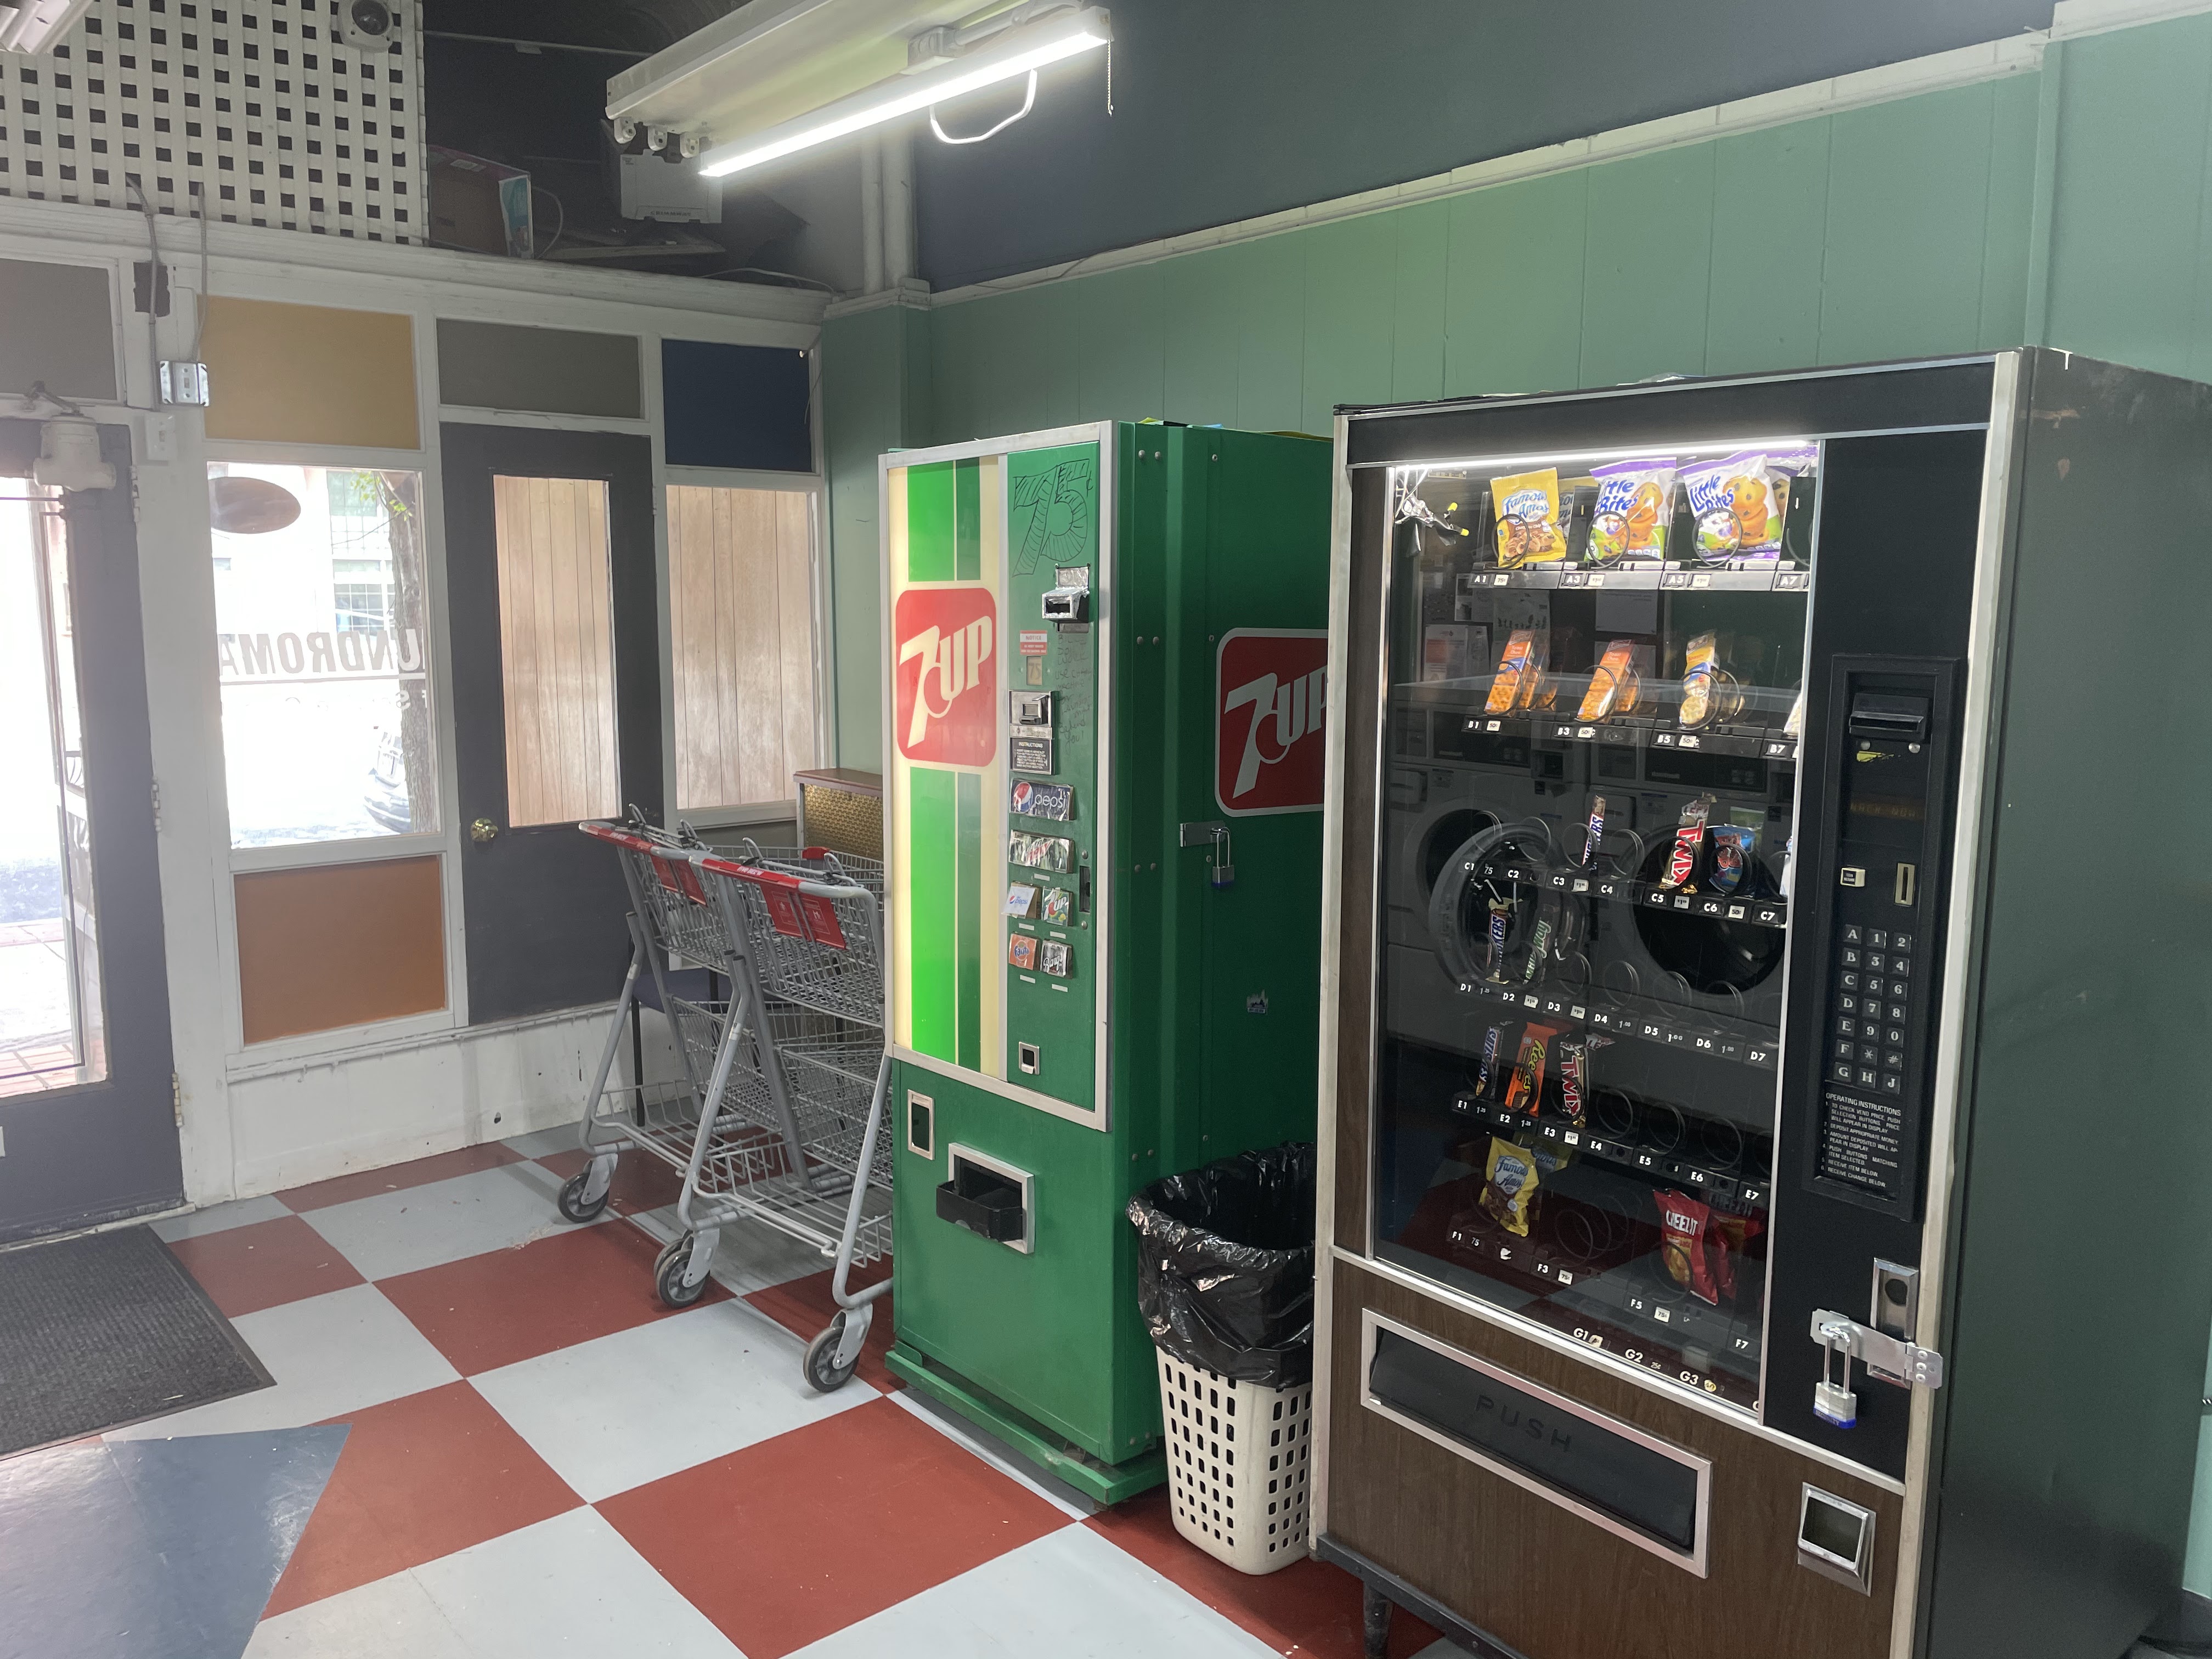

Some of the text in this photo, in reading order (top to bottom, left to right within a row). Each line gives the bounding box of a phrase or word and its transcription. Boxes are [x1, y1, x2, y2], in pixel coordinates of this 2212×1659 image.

[1690, 475, 1721, 512] Little
[1503, 492, 1547, 515] Famous
[1600, 495, 1639, 512] Bites
[1515, 503, 1549, 523] Amos
[1566, 575, 1581, 584] A3
[1669, 575, 1684, 584] A5
[1780, 576, 1798, 585] A7
[1468, 720, 1479, 729] B1
[1557, 727, 1570, 736] B3
[1657, 733, 1671, 744] B5
[1769, 744, 1785, 754] B7
[1034, 794, 1066, 810] pepsi
[1464, 862, 1475, 871] C1
[1484, 866, 1493, 874] 75
[1508, 870, 1519, 878] C2
[1553, 877, 1565, 886] C3
[1601, 884, 1613, 894] C4
[1651, 893, 1664, 903] C5
[1703, 903, 1718, 912] C6
[1760, 911, 1775, 921] C7
[1848, 929, 1905, 947] A 1 2
[1014, 945, 1030, 957] Fanta
[1847, 952, 1904, 971] B 3 4
[1460, 983, 1471, 992] D1
[1844, 975, 1902, 994] C 5 6
[1503, 992, 1515, 1001] D2
[1548, 1002, 1560, 1012] D3
[1843, 998, 1900, 1018] D 7 8
[1594, 1014, 1607, 1024] D4
[1645, 1025, 1658, 1036] D5
[1842, 1021, 1899, 1041] E 9 0
[1696, 1038, 1712, 1048] D6
[1840, 1044, 1849, 1053] F
[1750, 1051, 1766, 1062] D7
[1838, 1067, 1895, 1088] G H J
[1458, 1100, 1468, 1110] E1
[1826, 1092, 1901, 1116] OPERATING INSTRUCTIONS
[1499, 1114, 1511, 1124] E2
[1831, 1109, 1857, 1119] SELECTION
[1886, 1122, 1900, 1131] PRICE
[1839, 1104, 1855, 1113] CHECK
[1887, 1116, 1900, 1125] PUSH
[1843, 1118, 1861, 1127] APPEAR
[1544, 1127, 1556, 1137] E3
[1830, 1123, 1849, 1132] DEPOSIT
[1849, 1128, 1881, 1141] APPROPRIATE
[1590, 1141, 1602, 1151] E4
[1830, 1131, 1849, 1141] AMOUNT
[1850, 1136, 1876, 1148] DEPOSITED
[1877, 1143, 1889, 1152] WILL
[1639, 1155, 1651, 1166] E5
[1828, 1159, 1847, 1169] RECEIVE
[1846, 1149, 1867, 1160] BUTTONS
[1872, 1156, 1898, 1168] MATCHING
[1494, 1156, 1528, 1177] Famous
[1690, 1171, 1703, 1182] E6
[1827, 1167, 1847, 1177] RECEIVE
[1848, 1172, 1867, 1182] CHANGE
[1497, 1174, 1523, 1188] Amos
[1745, 1189, 1759, 1200] E7
[1452, 1231, 1462, 1241] F1
[1471, 1237, 1480, 1246] 75
[1537, 1263, 1548, 1273] F3
[1630, 1298, 1642, 1310] F5
[1573, 1328, 1589, 1340] G1
[1735, 1339, 1749, 1349] F7
[1625, 1348, 1644, 1363] G2
[1679, 1370, 1699, 1385] G3
[1475, 1395, 1572, 1453] PUSH
